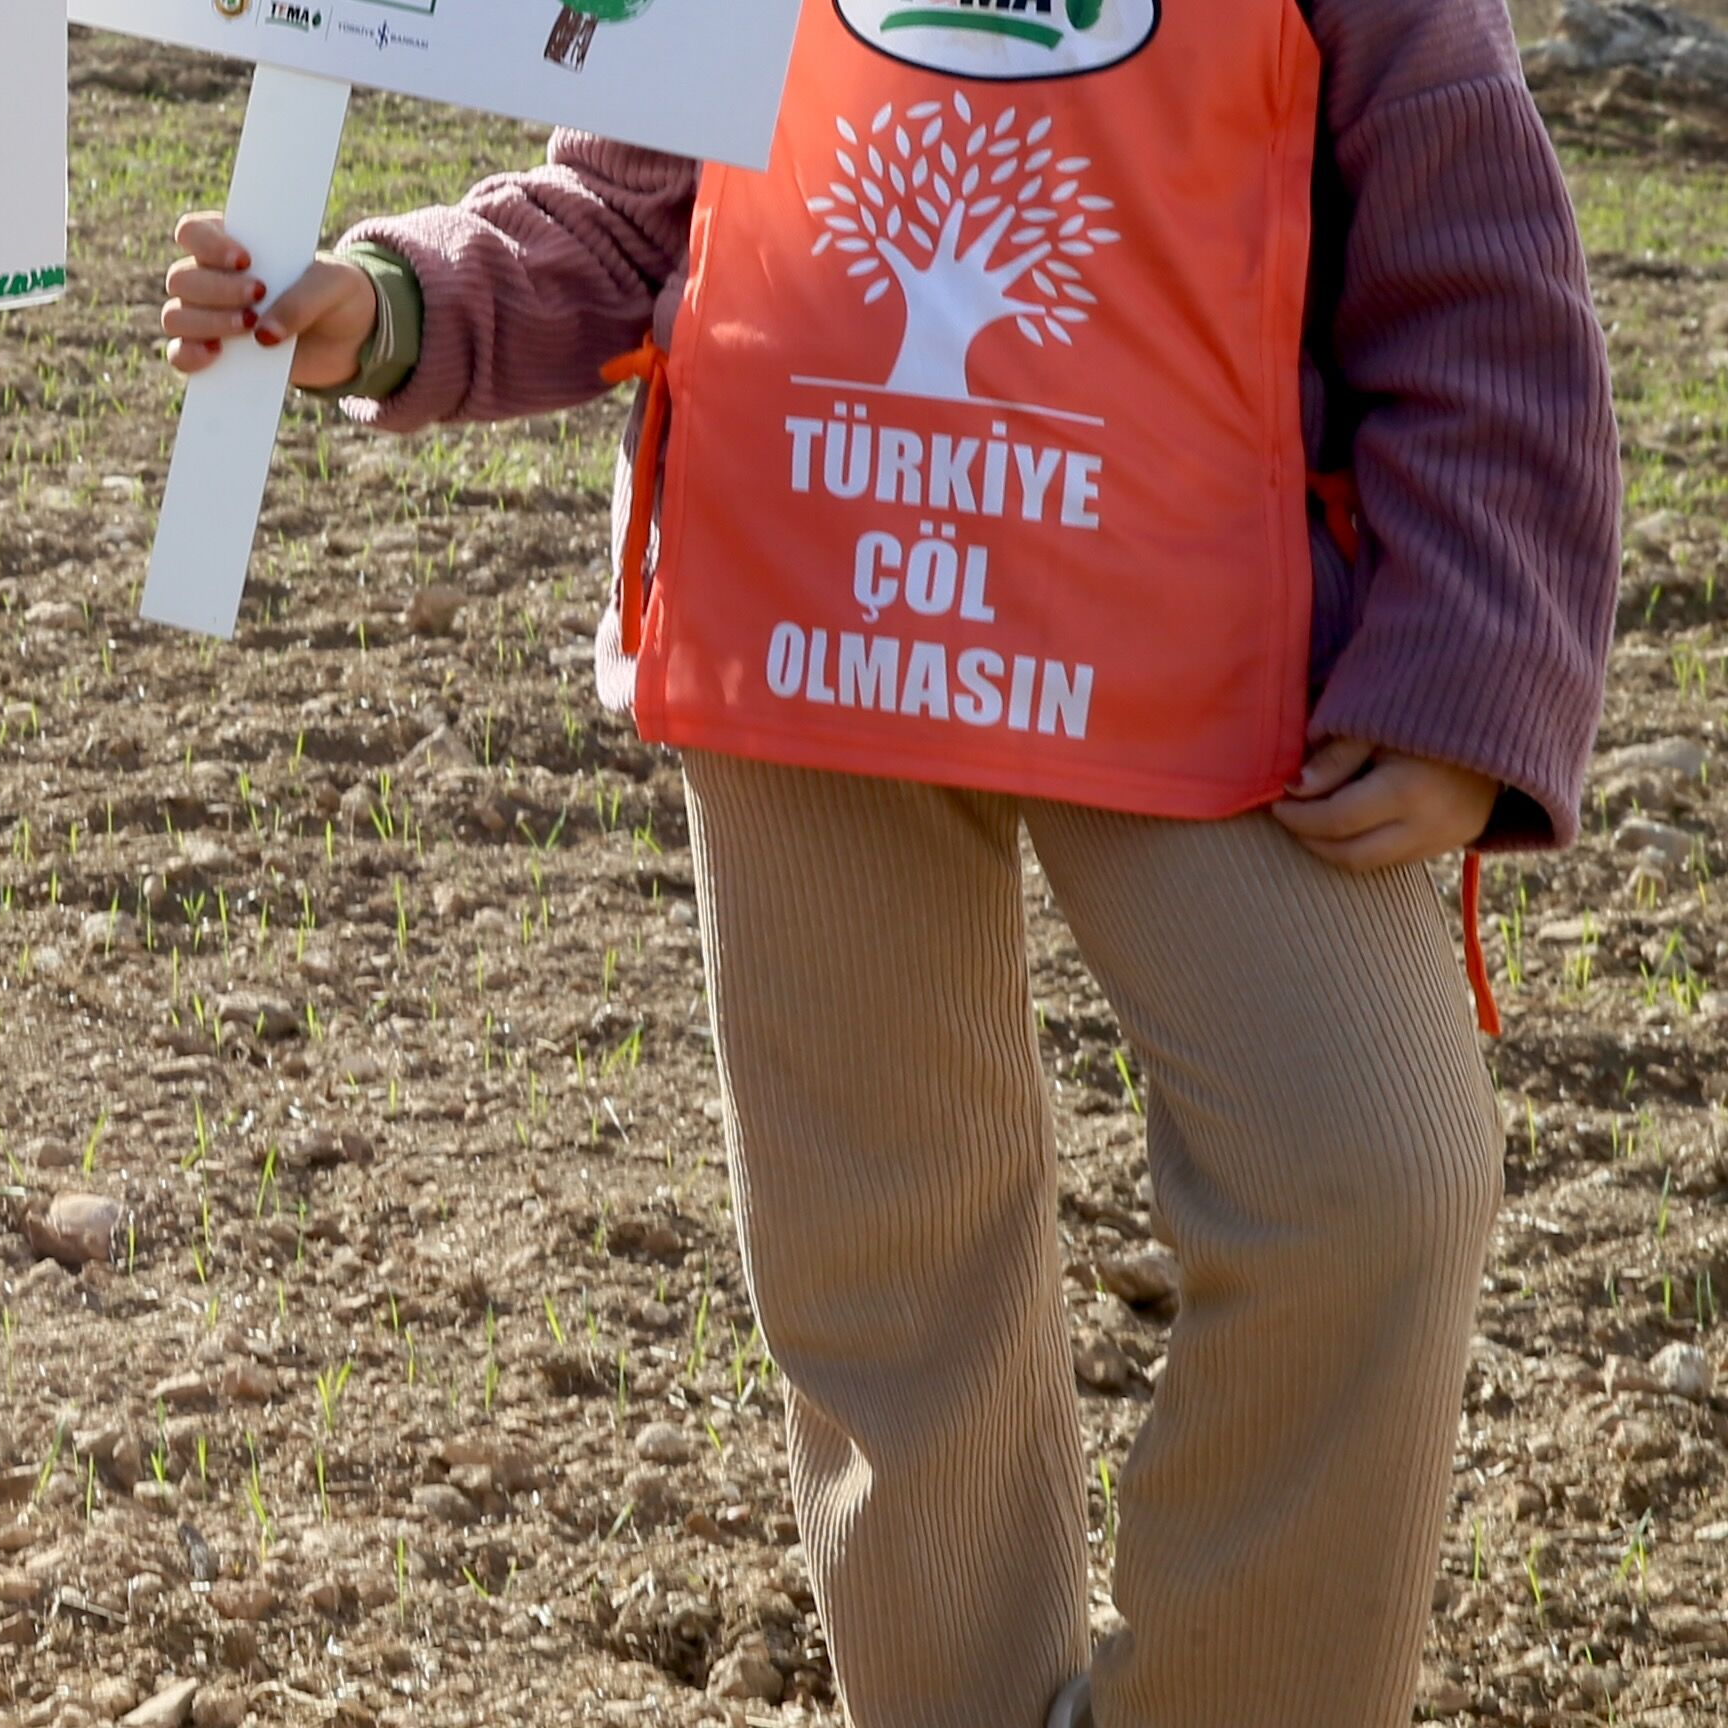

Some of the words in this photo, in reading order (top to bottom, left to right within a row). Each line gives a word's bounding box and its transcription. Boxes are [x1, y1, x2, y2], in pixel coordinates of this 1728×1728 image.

[271, 0, 310, 25] TEMA
[785, 401, 1104, 530] TÜRKİYE
[853, 522, 995, 623] ÇÖL
[765, 620, 1095, 741] OLMASIN
